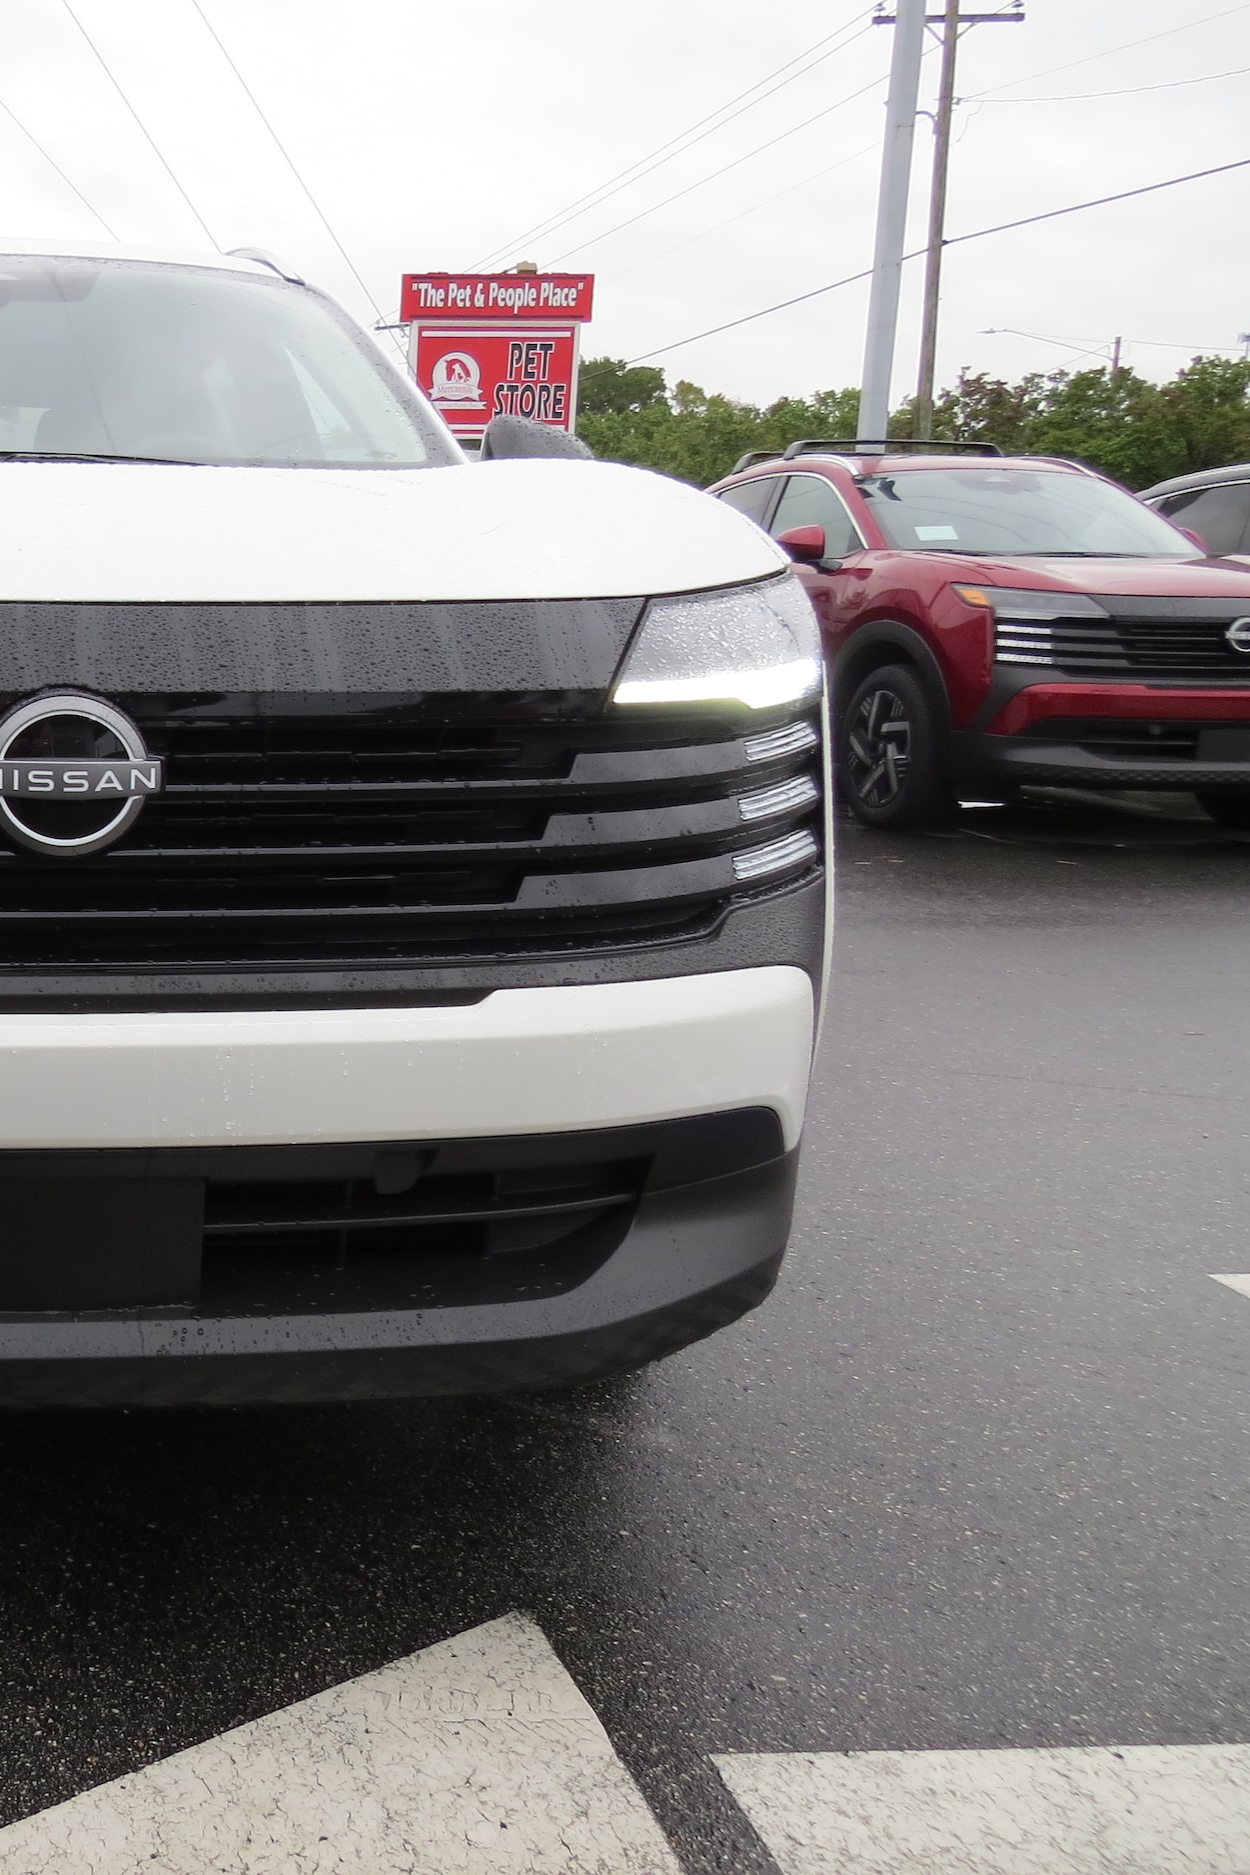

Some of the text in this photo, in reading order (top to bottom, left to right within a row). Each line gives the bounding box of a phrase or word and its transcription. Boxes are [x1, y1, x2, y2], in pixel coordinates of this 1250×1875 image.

[412, 281, 584, 315] "The Pet & People Place"
[507, 341, 555, 381] PET
[492, 383, 567, 420] STORE
